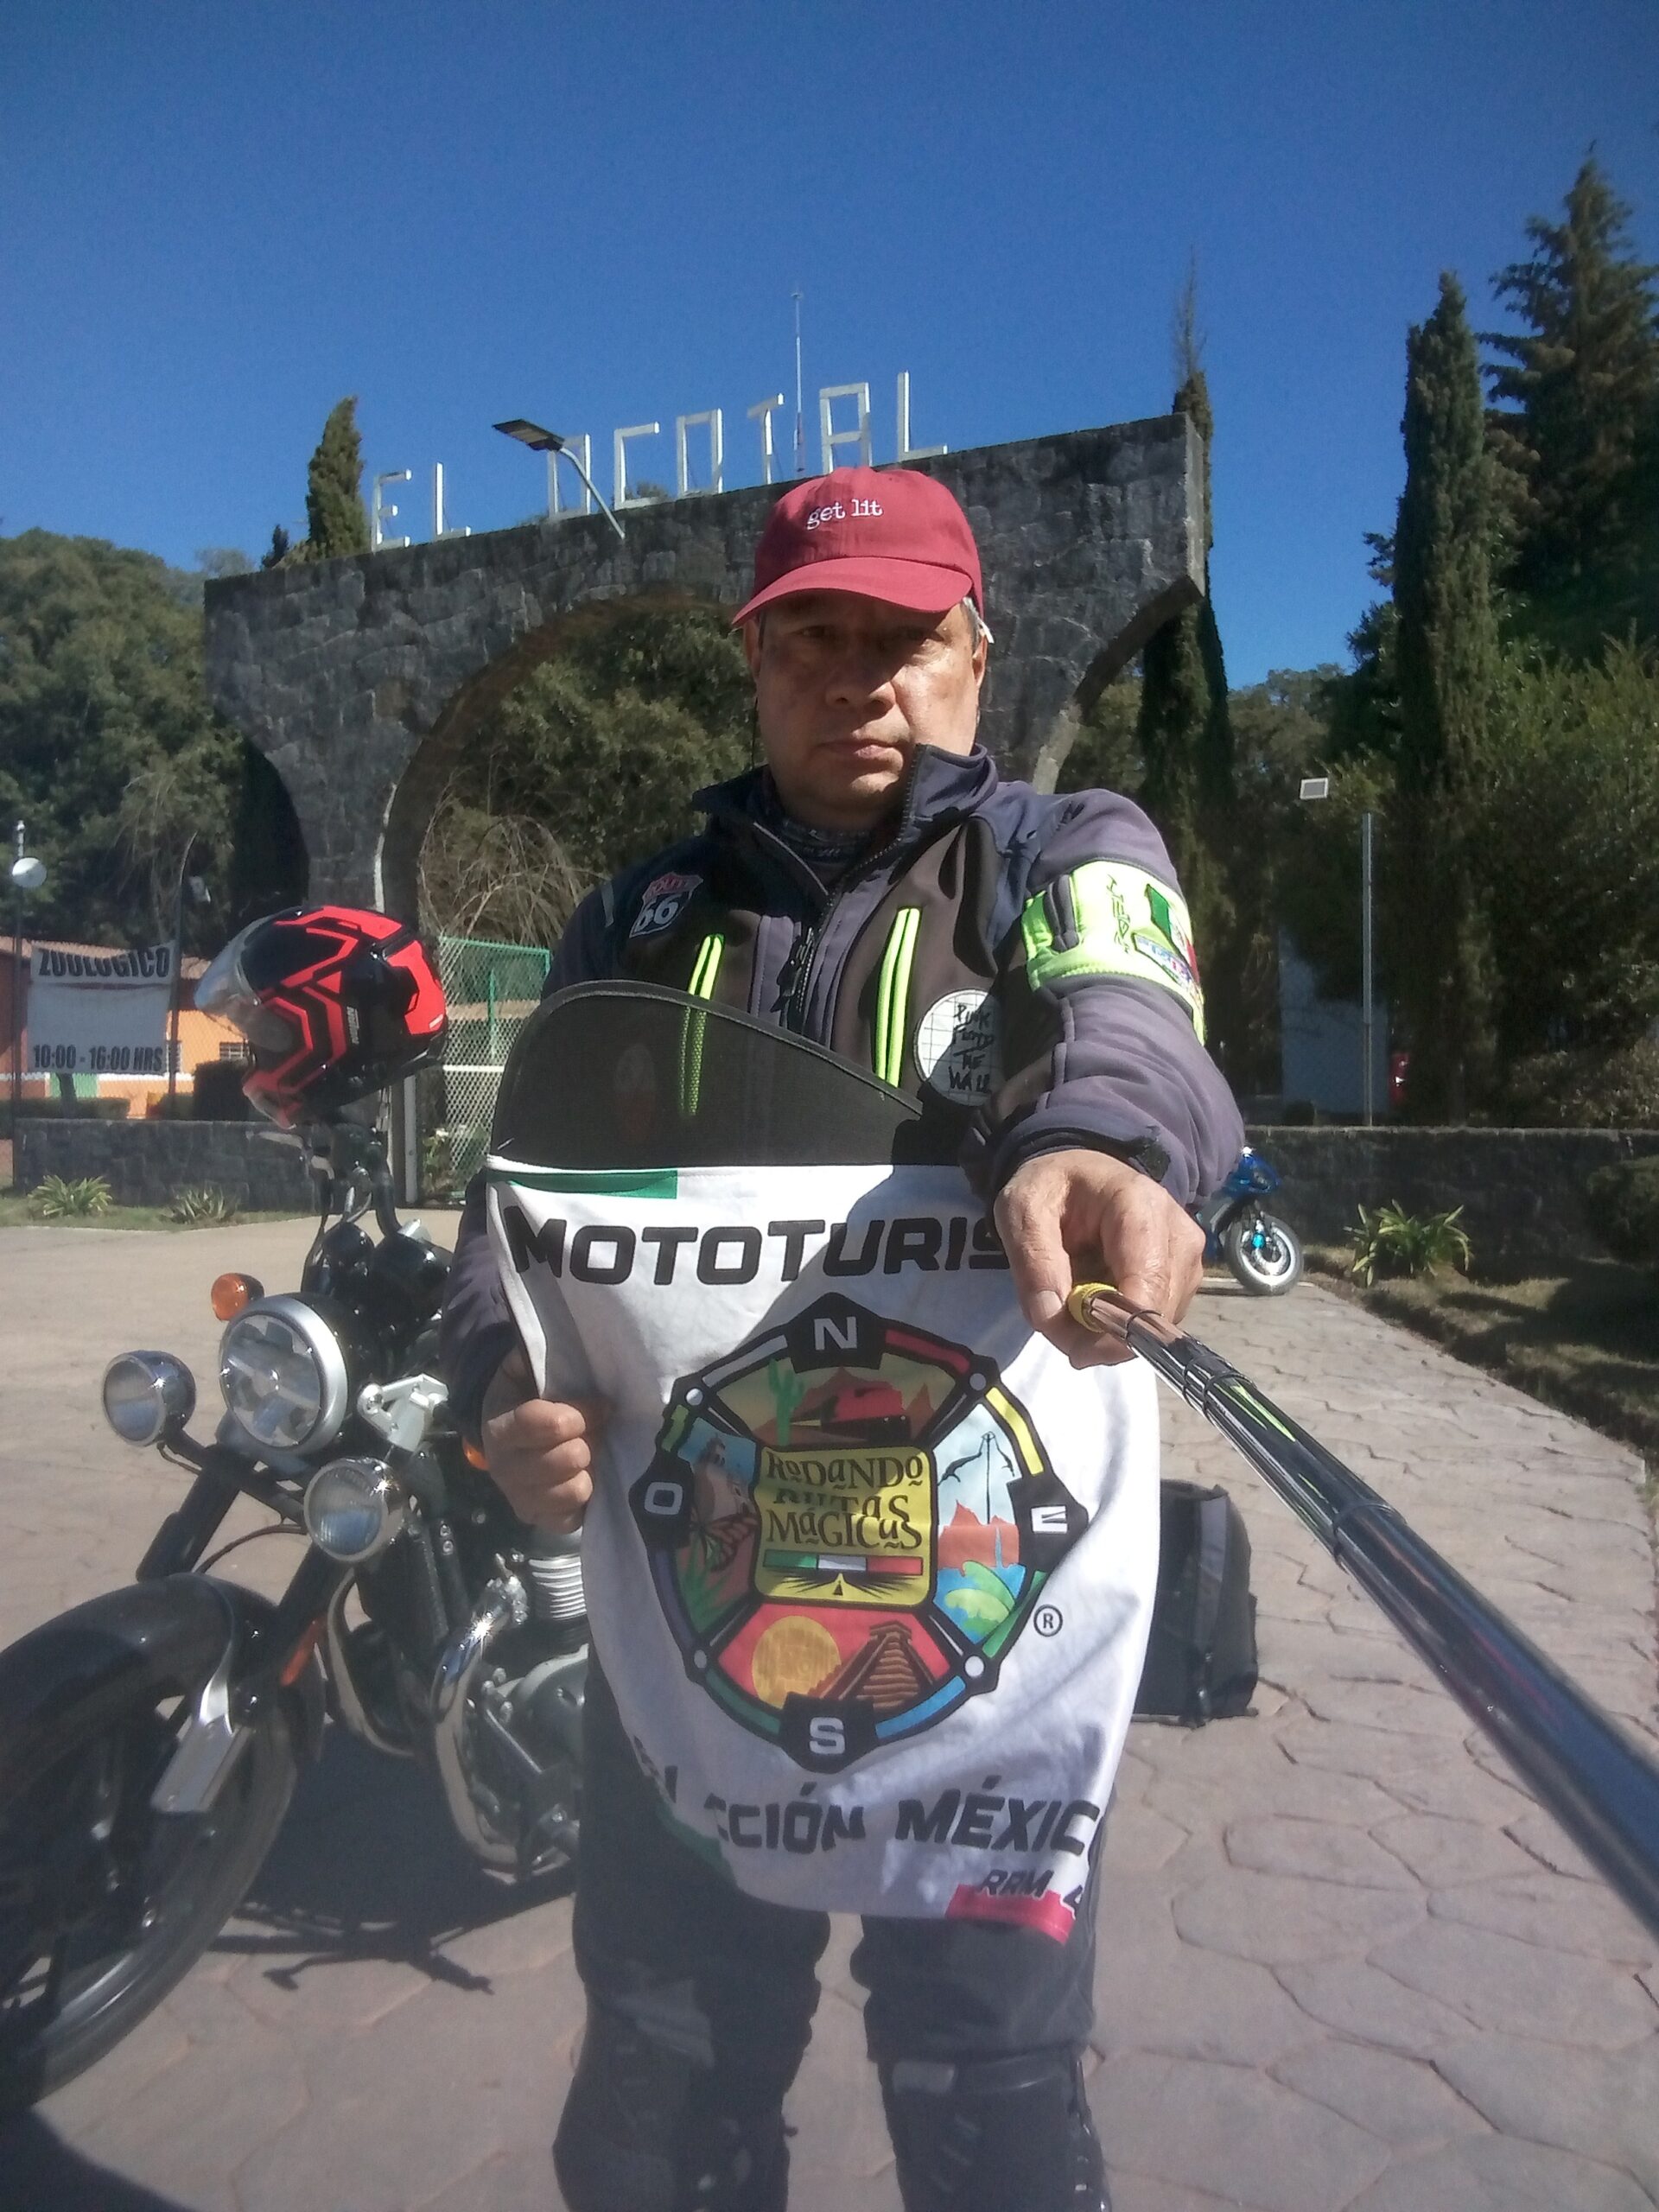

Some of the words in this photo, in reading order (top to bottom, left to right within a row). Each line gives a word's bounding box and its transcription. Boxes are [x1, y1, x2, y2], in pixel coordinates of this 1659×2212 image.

[372, 462, 472, 553] EL
[547, 369, 948, 520] OCOTAL
[807, 502, 846, 530] get
[851, 499, 883, 517] lit
[634, 894, 681, 932] 66
[33, 1044, 76, 1069] 10:00
[89, 1046, 130, 1071] 16:00
[133, 1046, 163, 1071] HRS
[953, 1045, 986, 1070] THE
[503, 1205, 1010, 1286] MOTOTURIS
[813, 1316, 858, 1351] N
[644, 1482, 683, 1516] O
[809, 1716, 846, 1755] S
[895, 1775, 1102, 1856] MÉXIC
